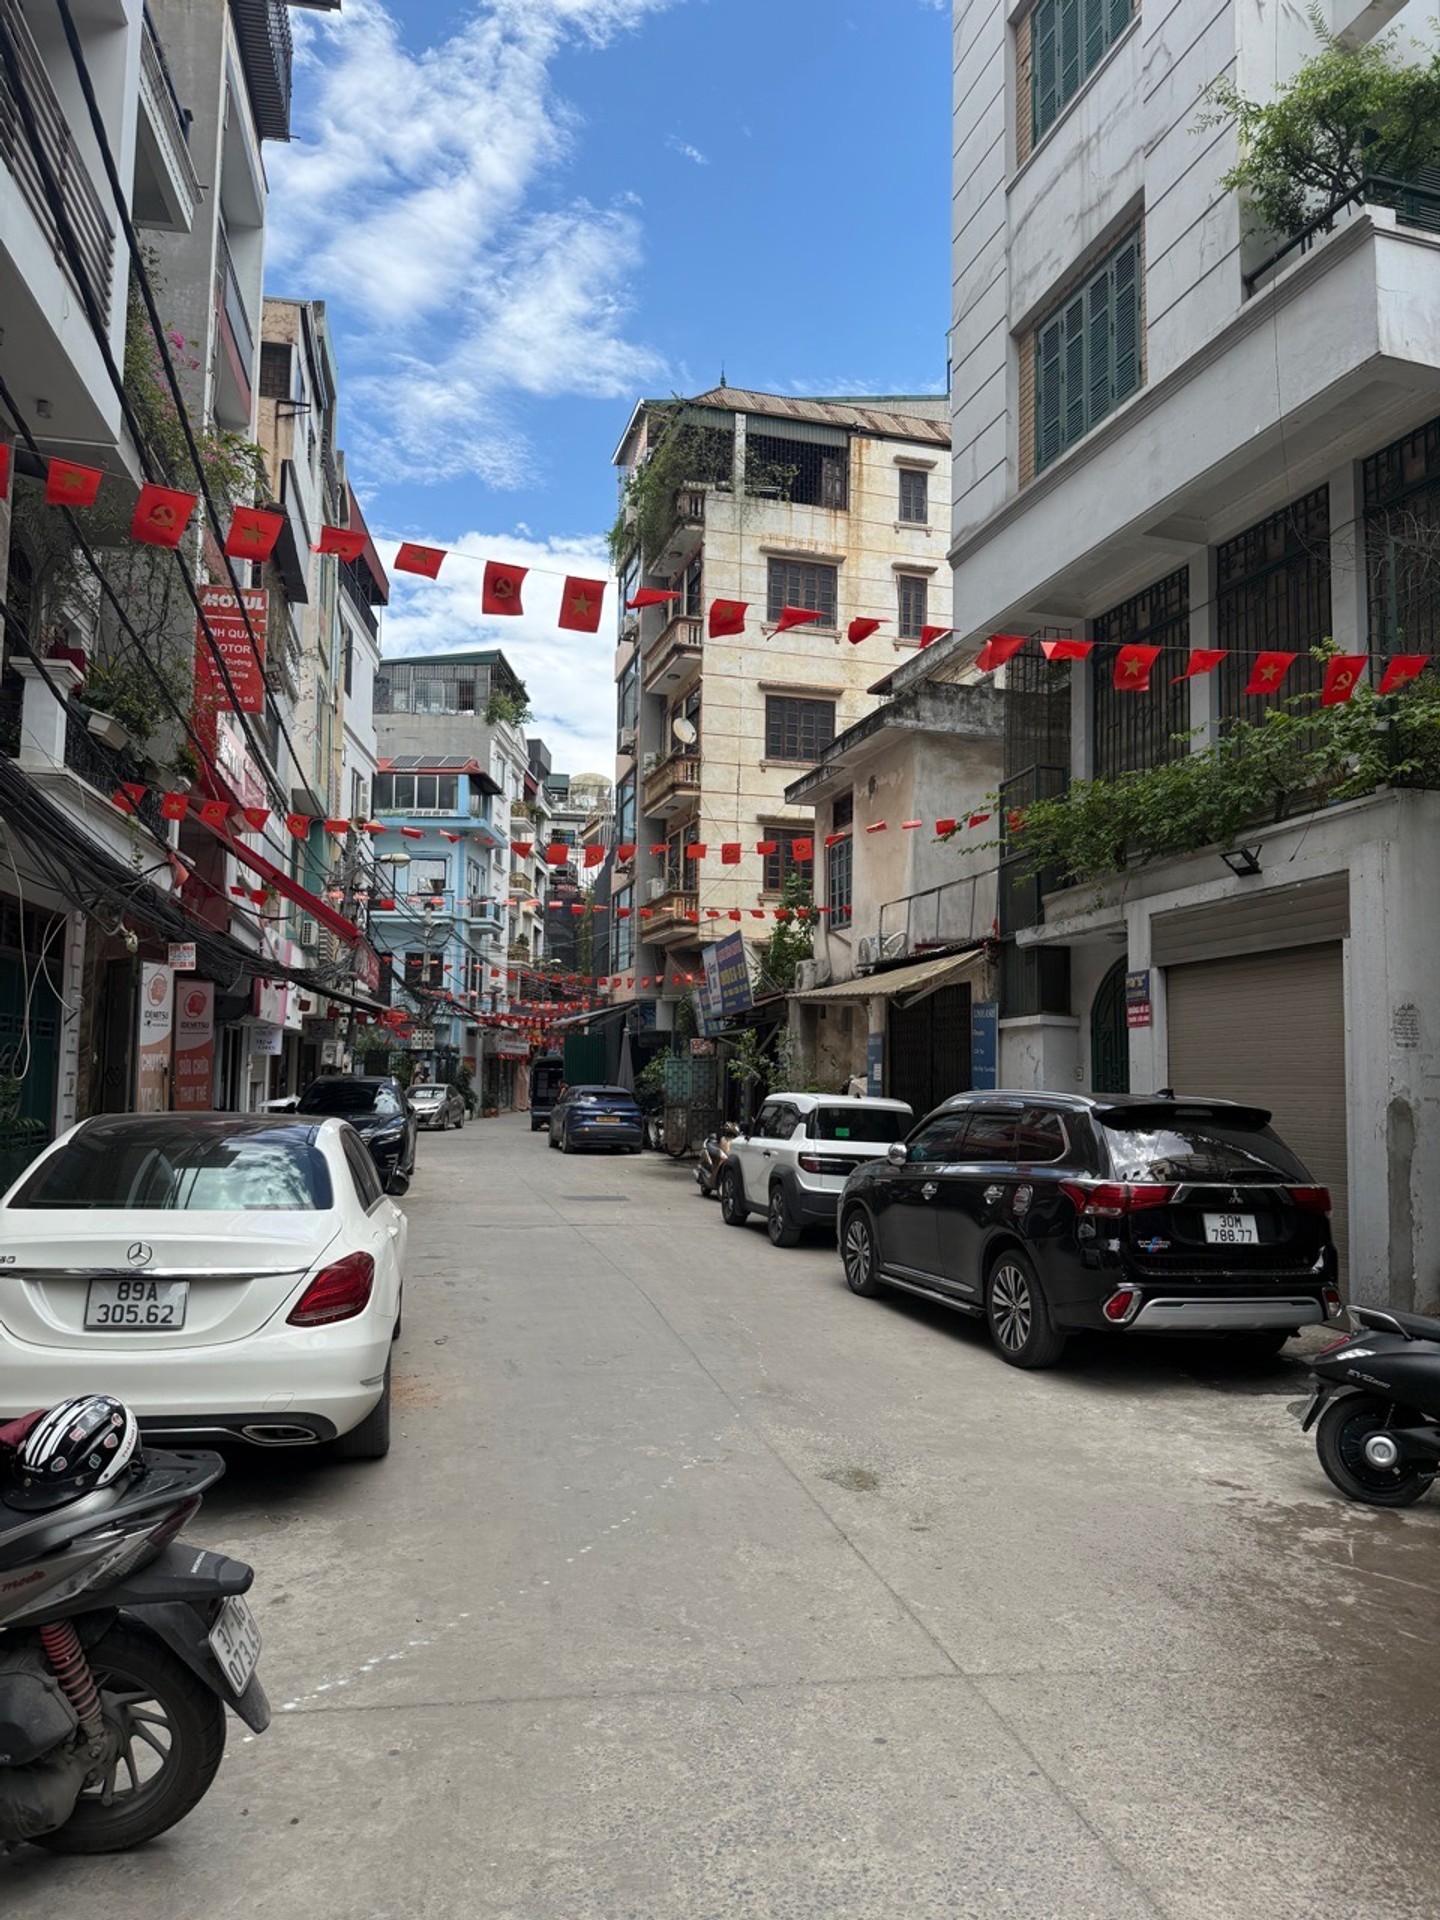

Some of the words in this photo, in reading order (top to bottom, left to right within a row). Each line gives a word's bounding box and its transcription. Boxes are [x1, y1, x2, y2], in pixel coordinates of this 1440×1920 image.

[201, 592, 265, 610] MOTUL
[201, 627, 225, 637] NH
[228, 628, 261, 640] QUN
[213, 643, 252, 655] OTOR
[180, 1021, 210, 1029] IDEMITSU
[1219, 1215, 1243, 1228] 30M
[1211, 1229, 1253, 1242] 788.77
[117, 1281, 158, 1301] 89A
[96, 1304, 174, 1324] 305.62
